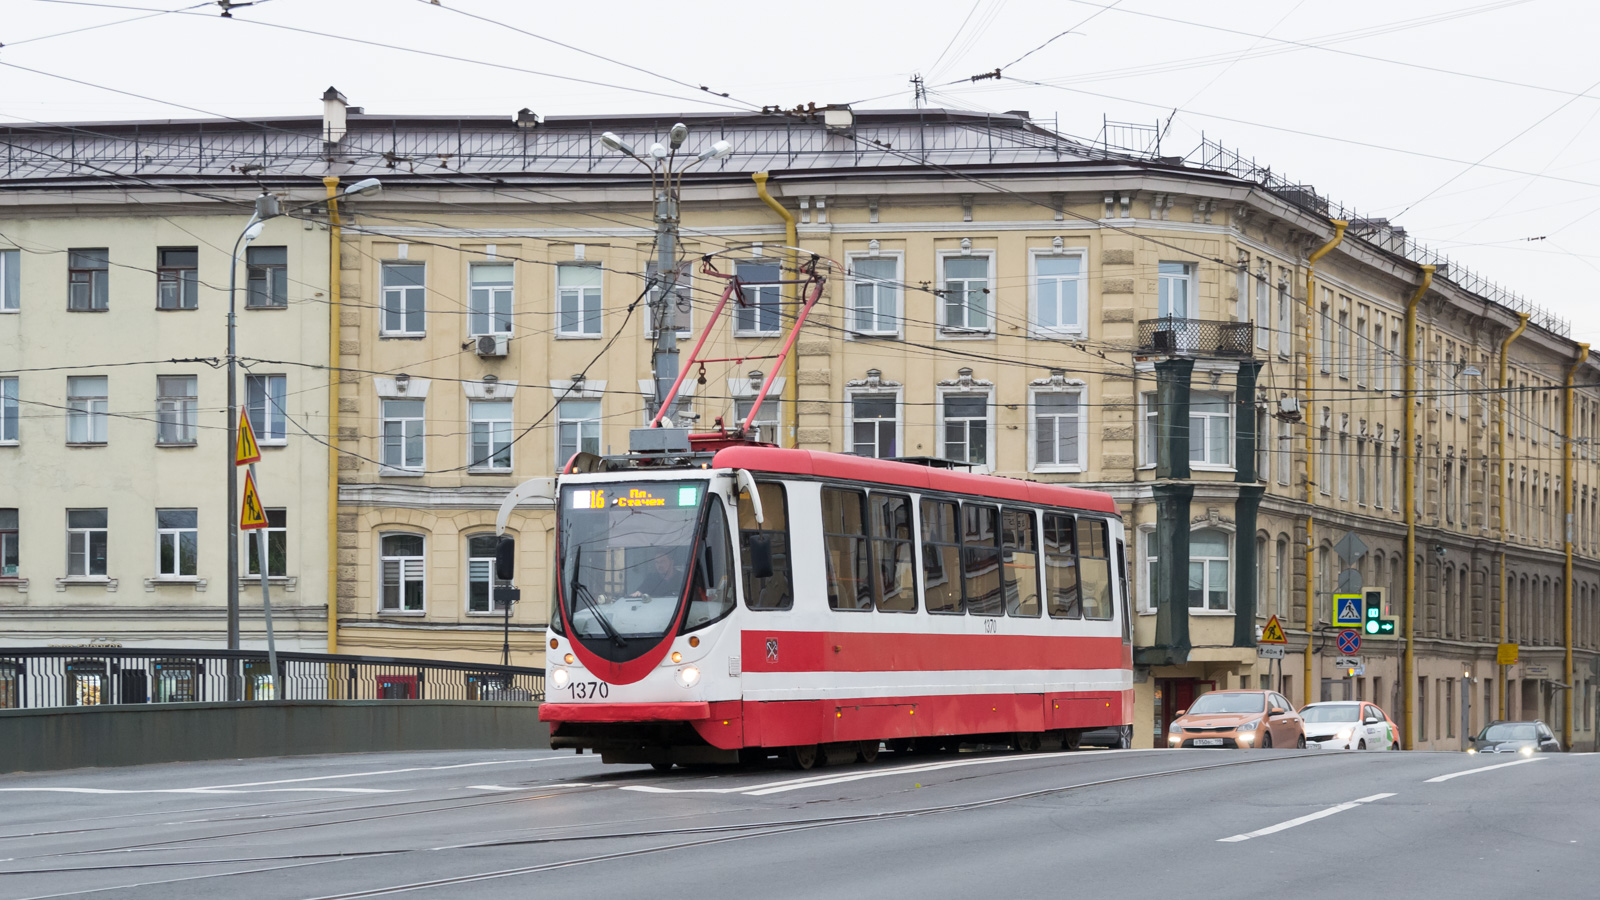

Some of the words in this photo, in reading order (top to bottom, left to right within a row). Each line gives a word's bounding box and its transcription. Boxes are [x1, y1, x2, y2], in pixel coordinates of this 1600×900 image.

[590, 490, 605, 509] 16
[629, 488, 652, 498] Пл.
[618, 497, 665, 507] Стачек
[983, 618, 997, 634] 1370
[567, 681, 609, 700] 1370
